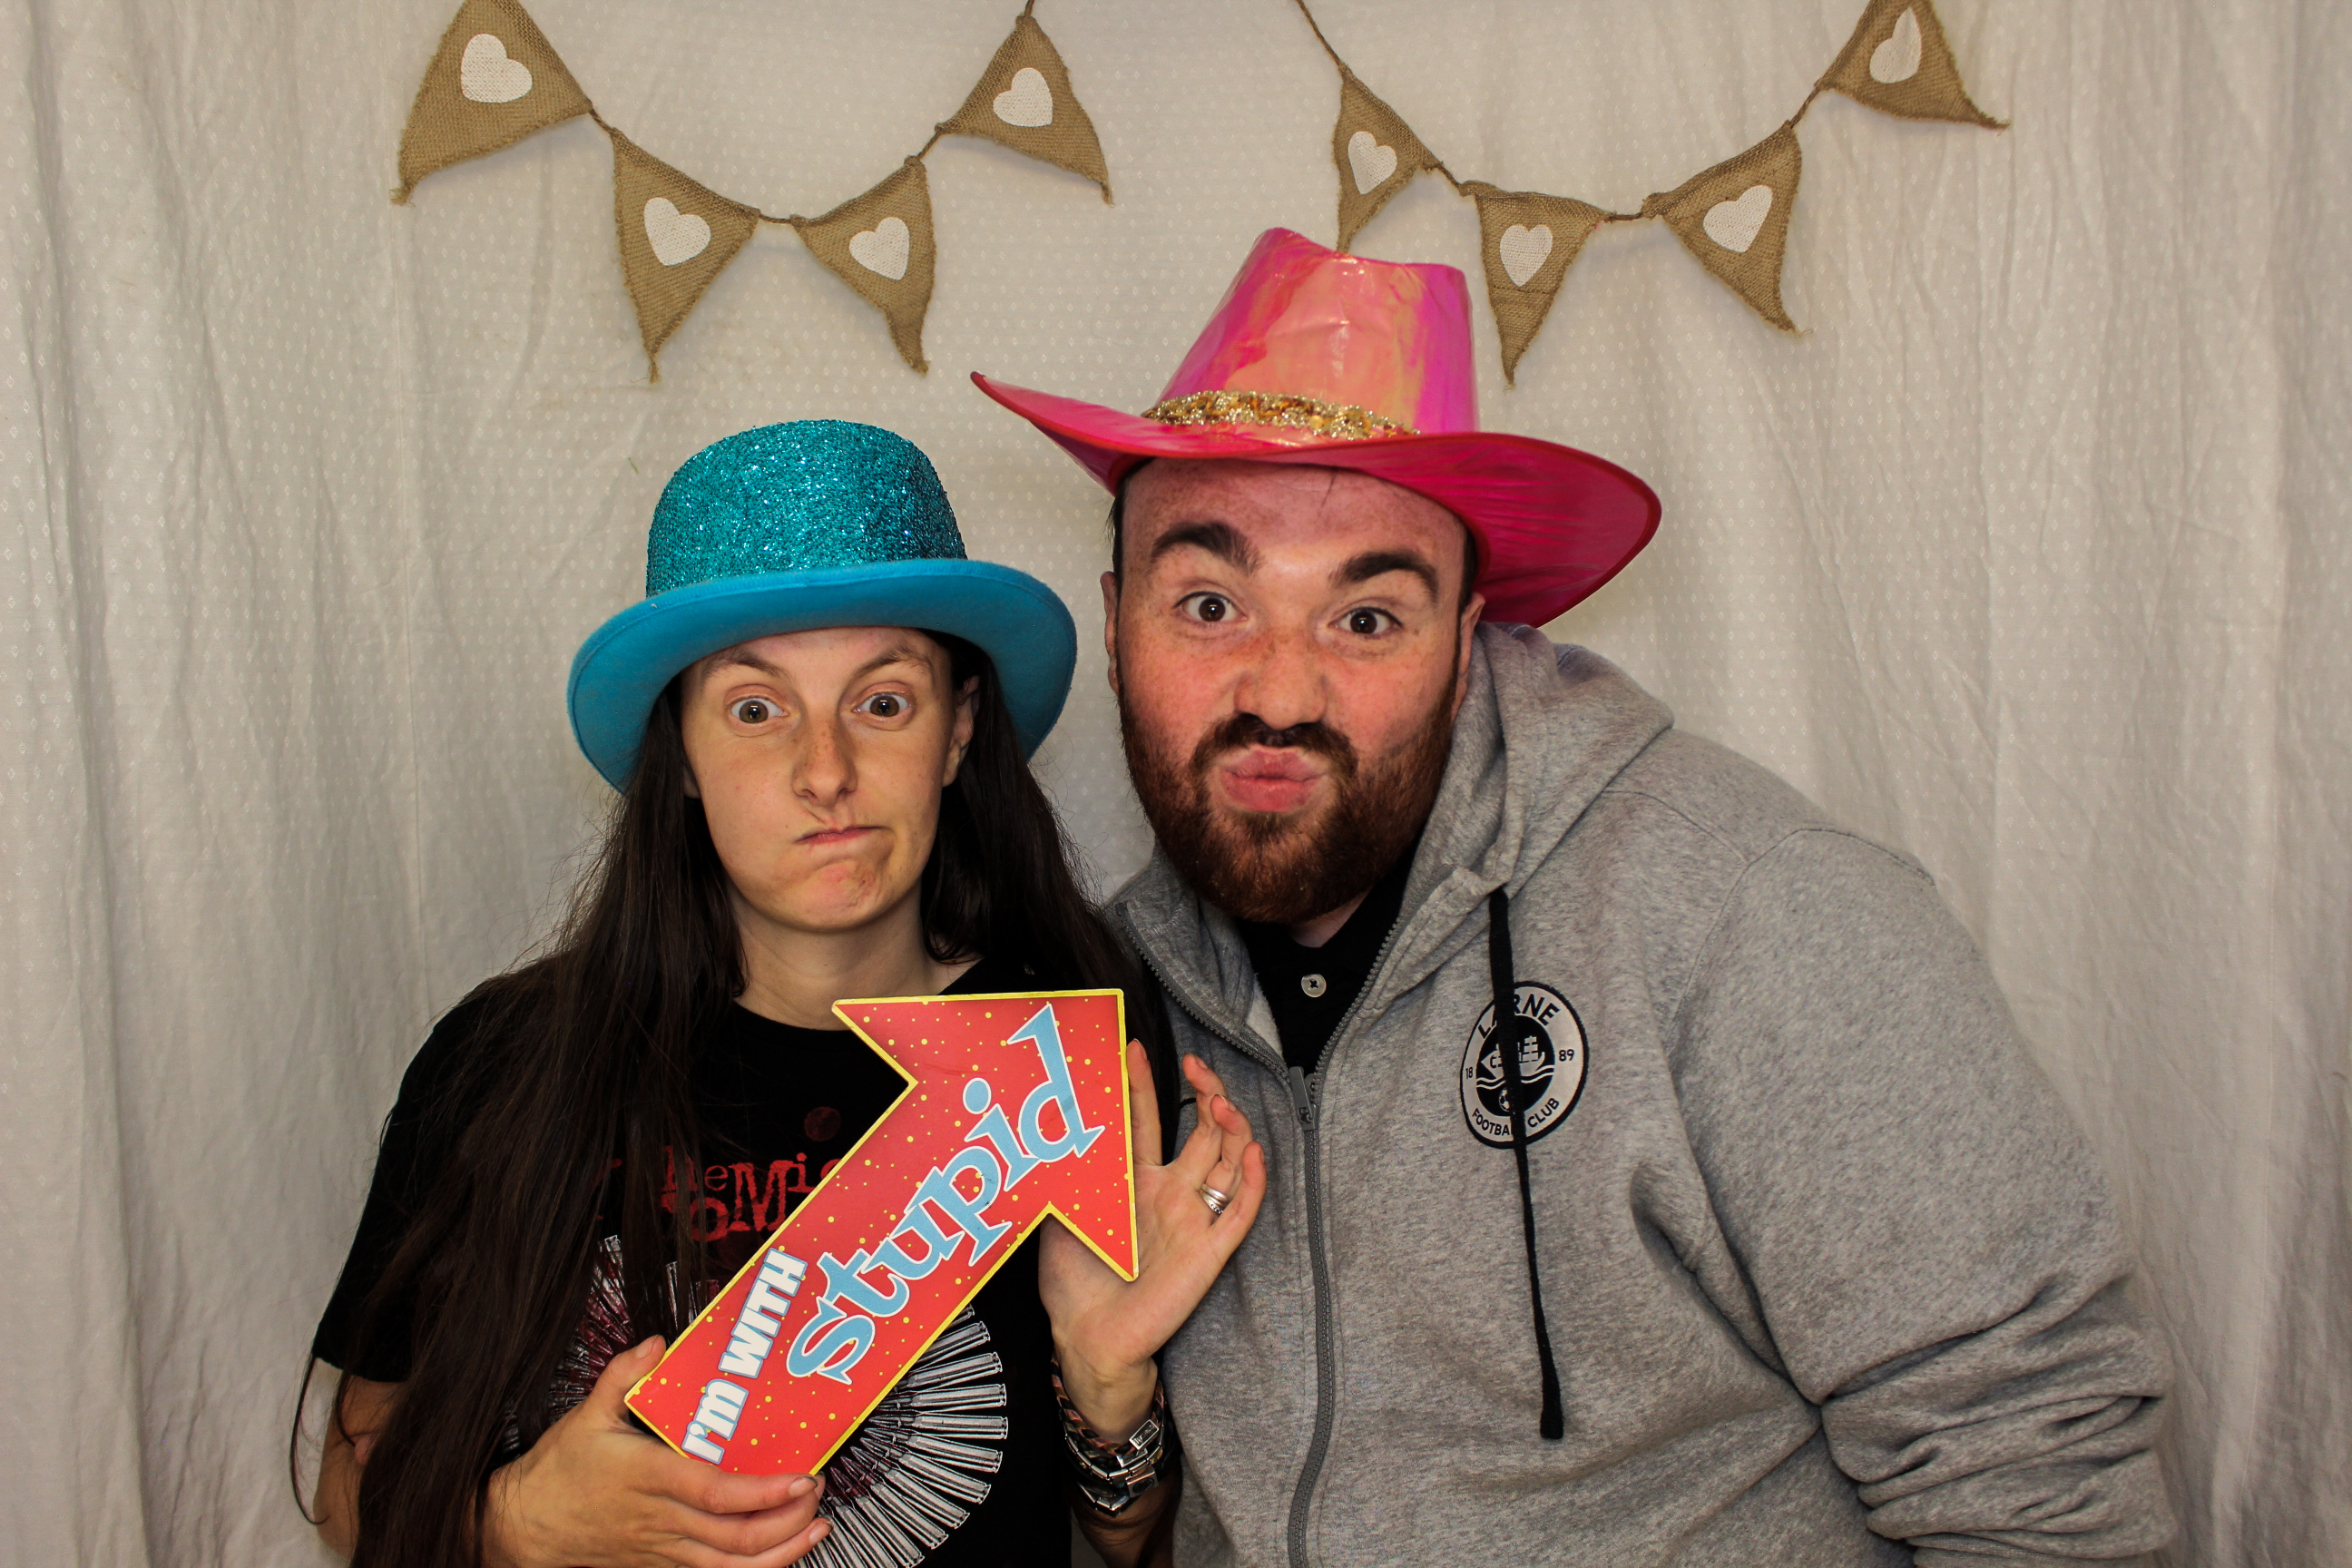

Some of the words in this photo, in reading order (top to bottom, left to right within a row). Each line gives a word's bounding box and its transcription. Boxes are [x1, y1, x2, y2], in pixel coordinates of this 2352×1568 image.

[1477, 993, 1561, 1040] LRNE
[1465, 1066, 1474, 1080] 18
[1558, 1049, 1575, 1063] 89
[1471, 1107, 1511, 1136] FOOTBA
[1527, 1097, 1560, 1128] CLUB
[718, 1247, 808, 1378] WITH
